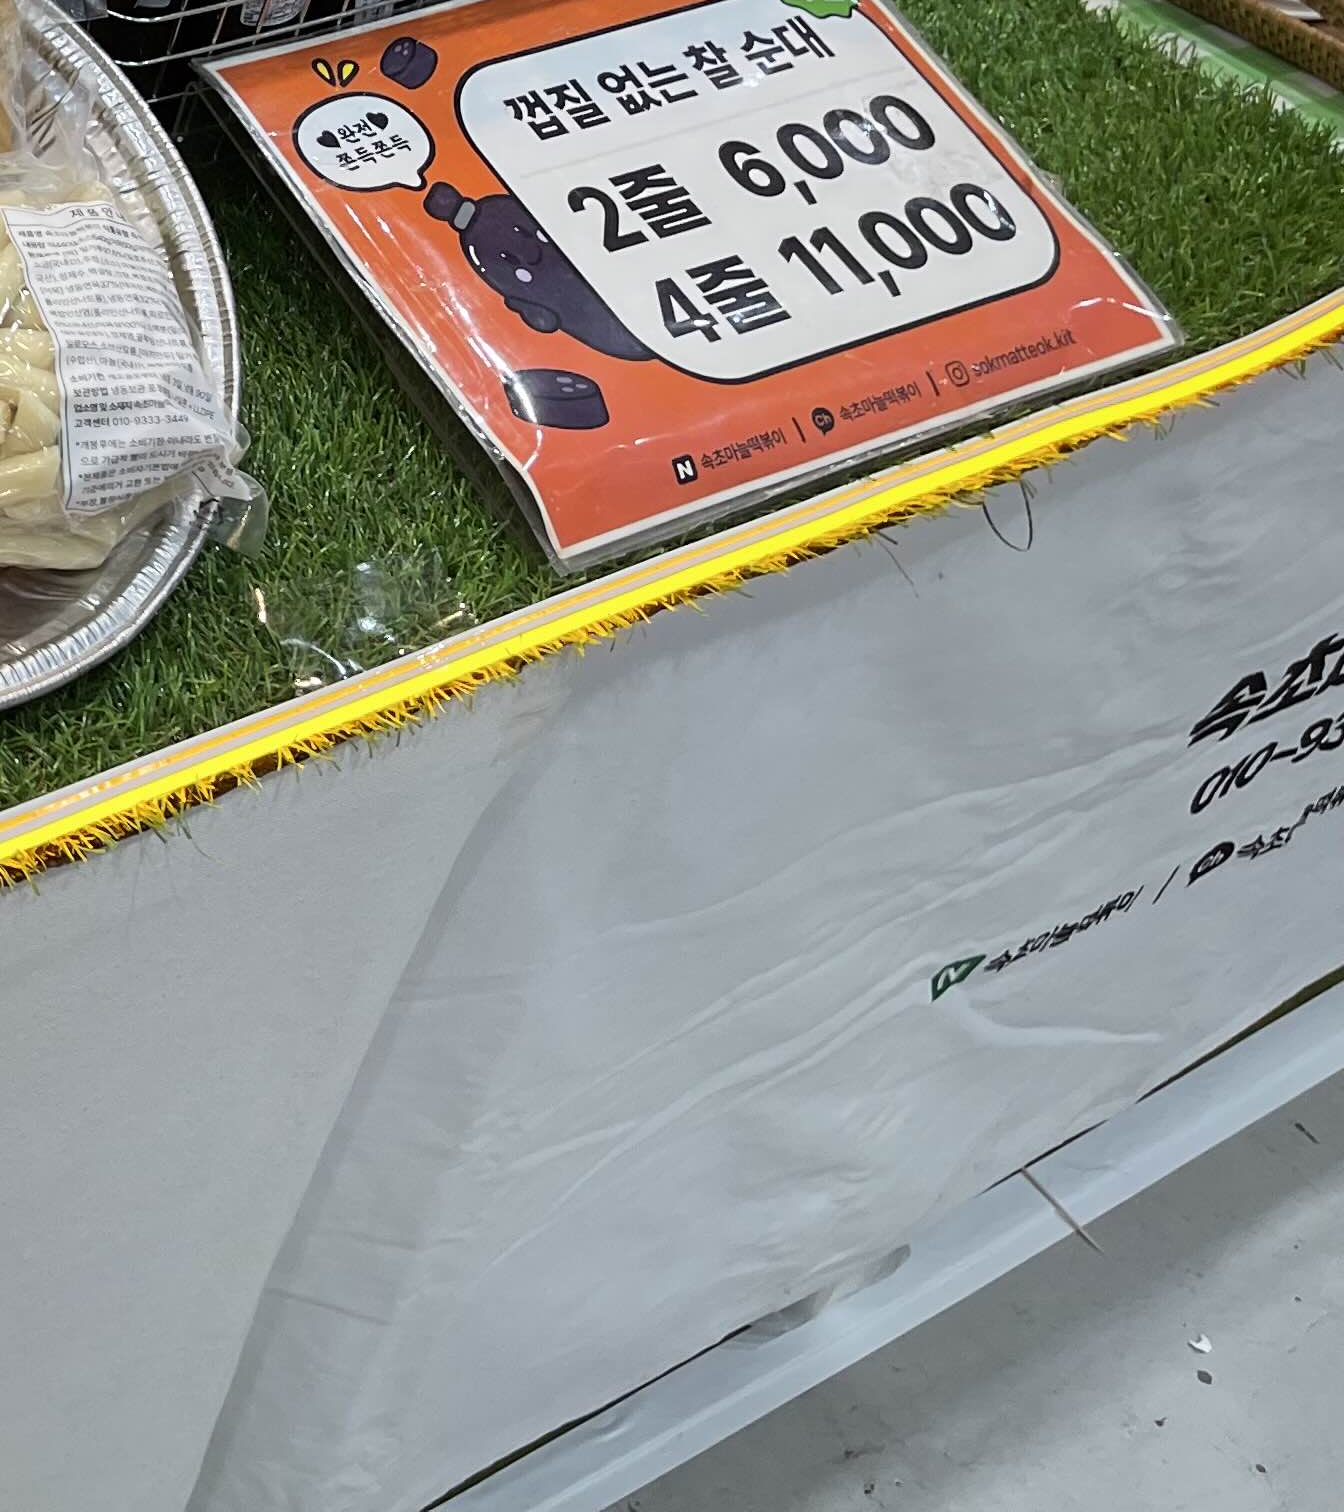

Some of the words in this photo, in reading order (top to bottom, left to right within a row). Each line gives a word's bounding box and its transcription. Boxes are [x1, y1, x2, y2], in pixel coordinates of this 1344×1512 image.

[503, 79, 612, 141] 껍질
[597, 60, 699, 114] 없는
[683, 40, 745, 88] 찰
[740, 15, 837, 76] 순대
[567, 163, 713, 252] 2줄
[718, 94, 936, 206] 6,000
[654, 254, 793, 343] 4줄
[777, 182, 1017, 297] 11,000
[699, 429, 789, 472] 속초마늘떡볶이
[838, 380, 922, 422] 속초마늘떡볶이
[971, 328, 1078, 378] sokmatteok.kit
[1188, 632, 1344, 748] 속초
